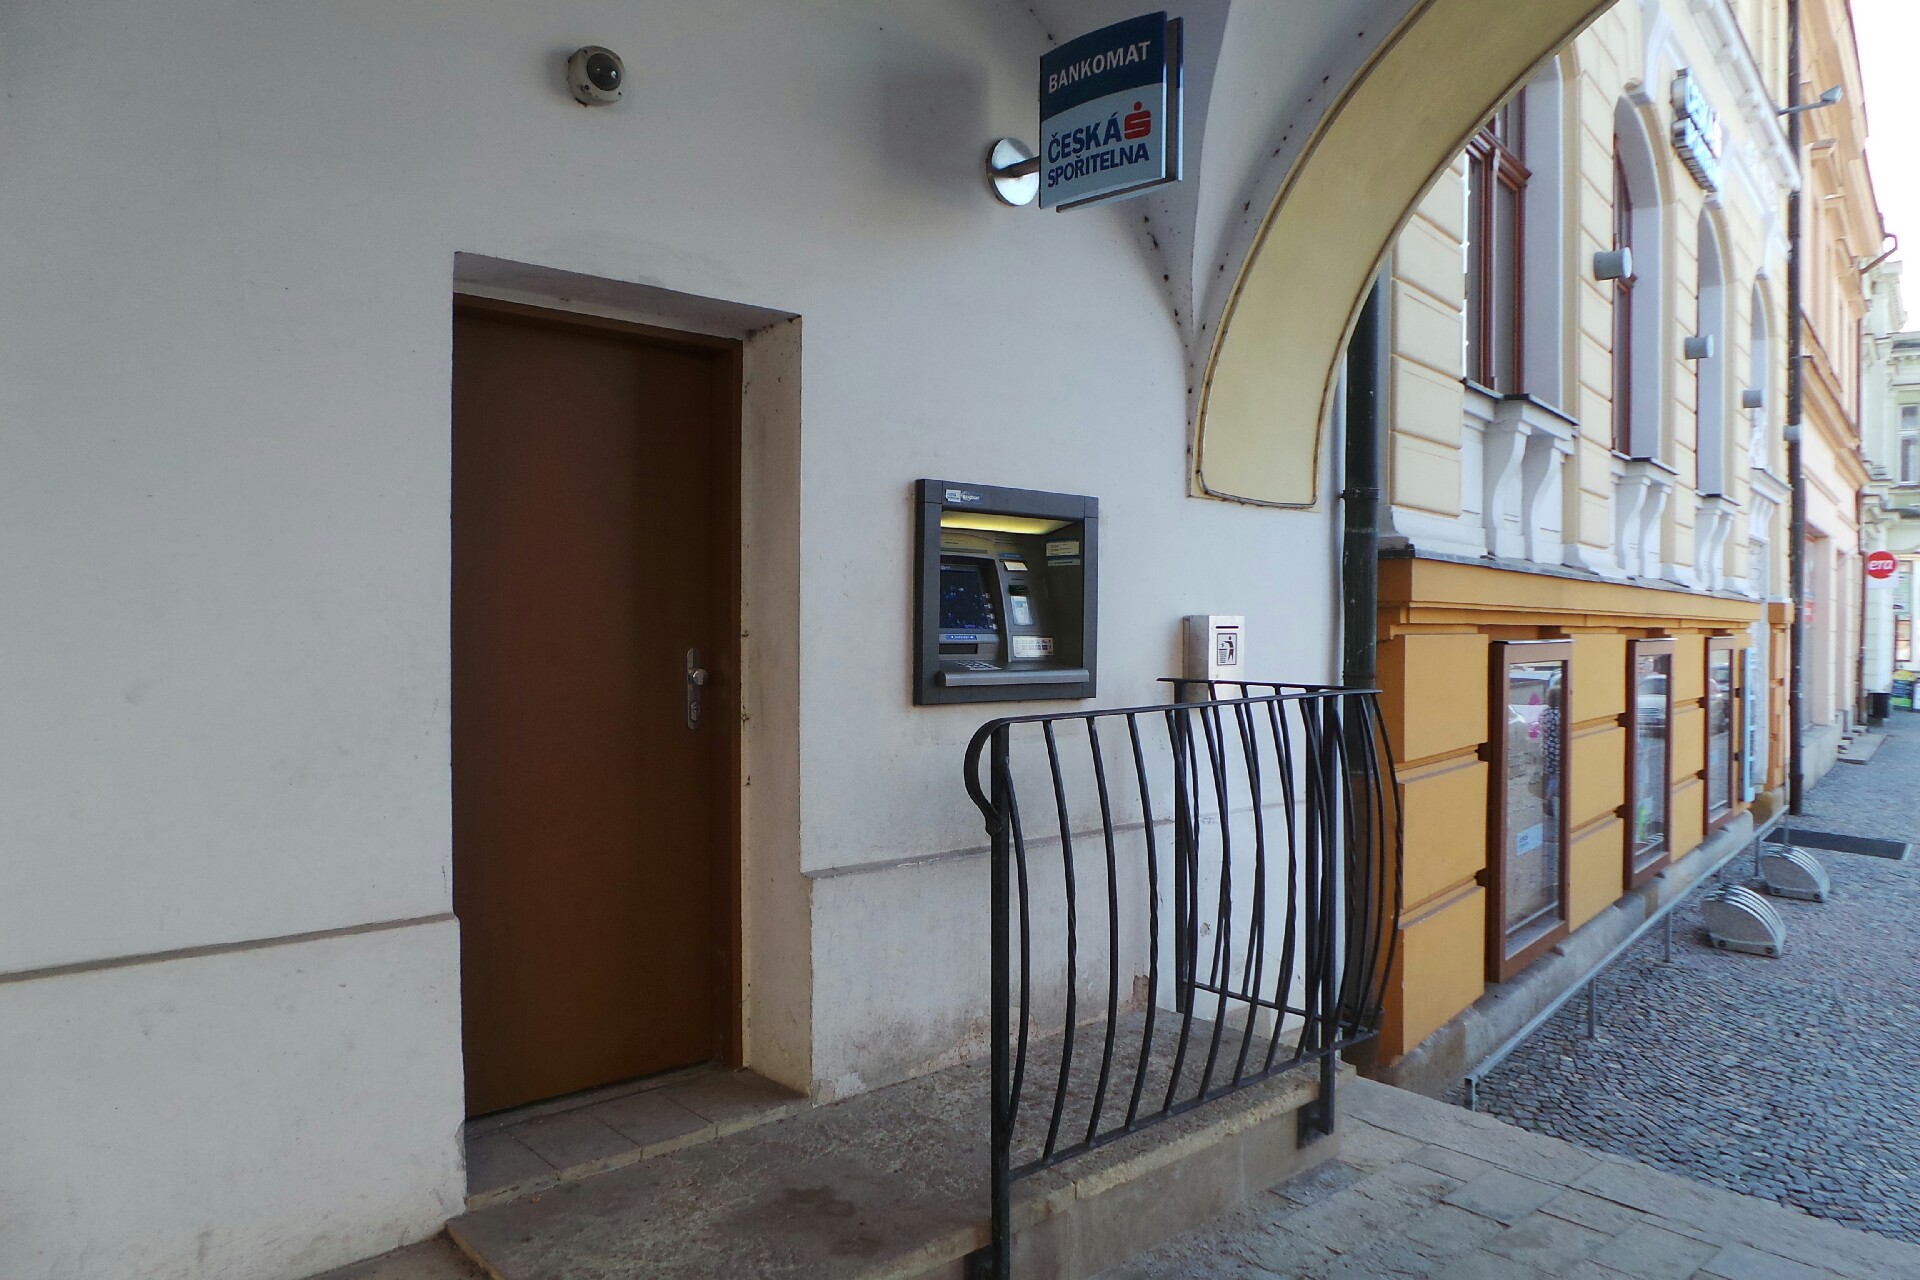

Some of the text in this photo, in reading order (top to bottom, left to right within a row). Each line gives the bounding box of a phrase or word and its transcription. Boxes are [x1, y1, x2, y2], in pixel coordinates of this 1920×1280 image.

[1048, 41, 1151, 94] BANKOMAT
[1047, 111, 1122, 163] ČESKÁ
[1047, 142, 1149, 187] SPOŘITELNA
